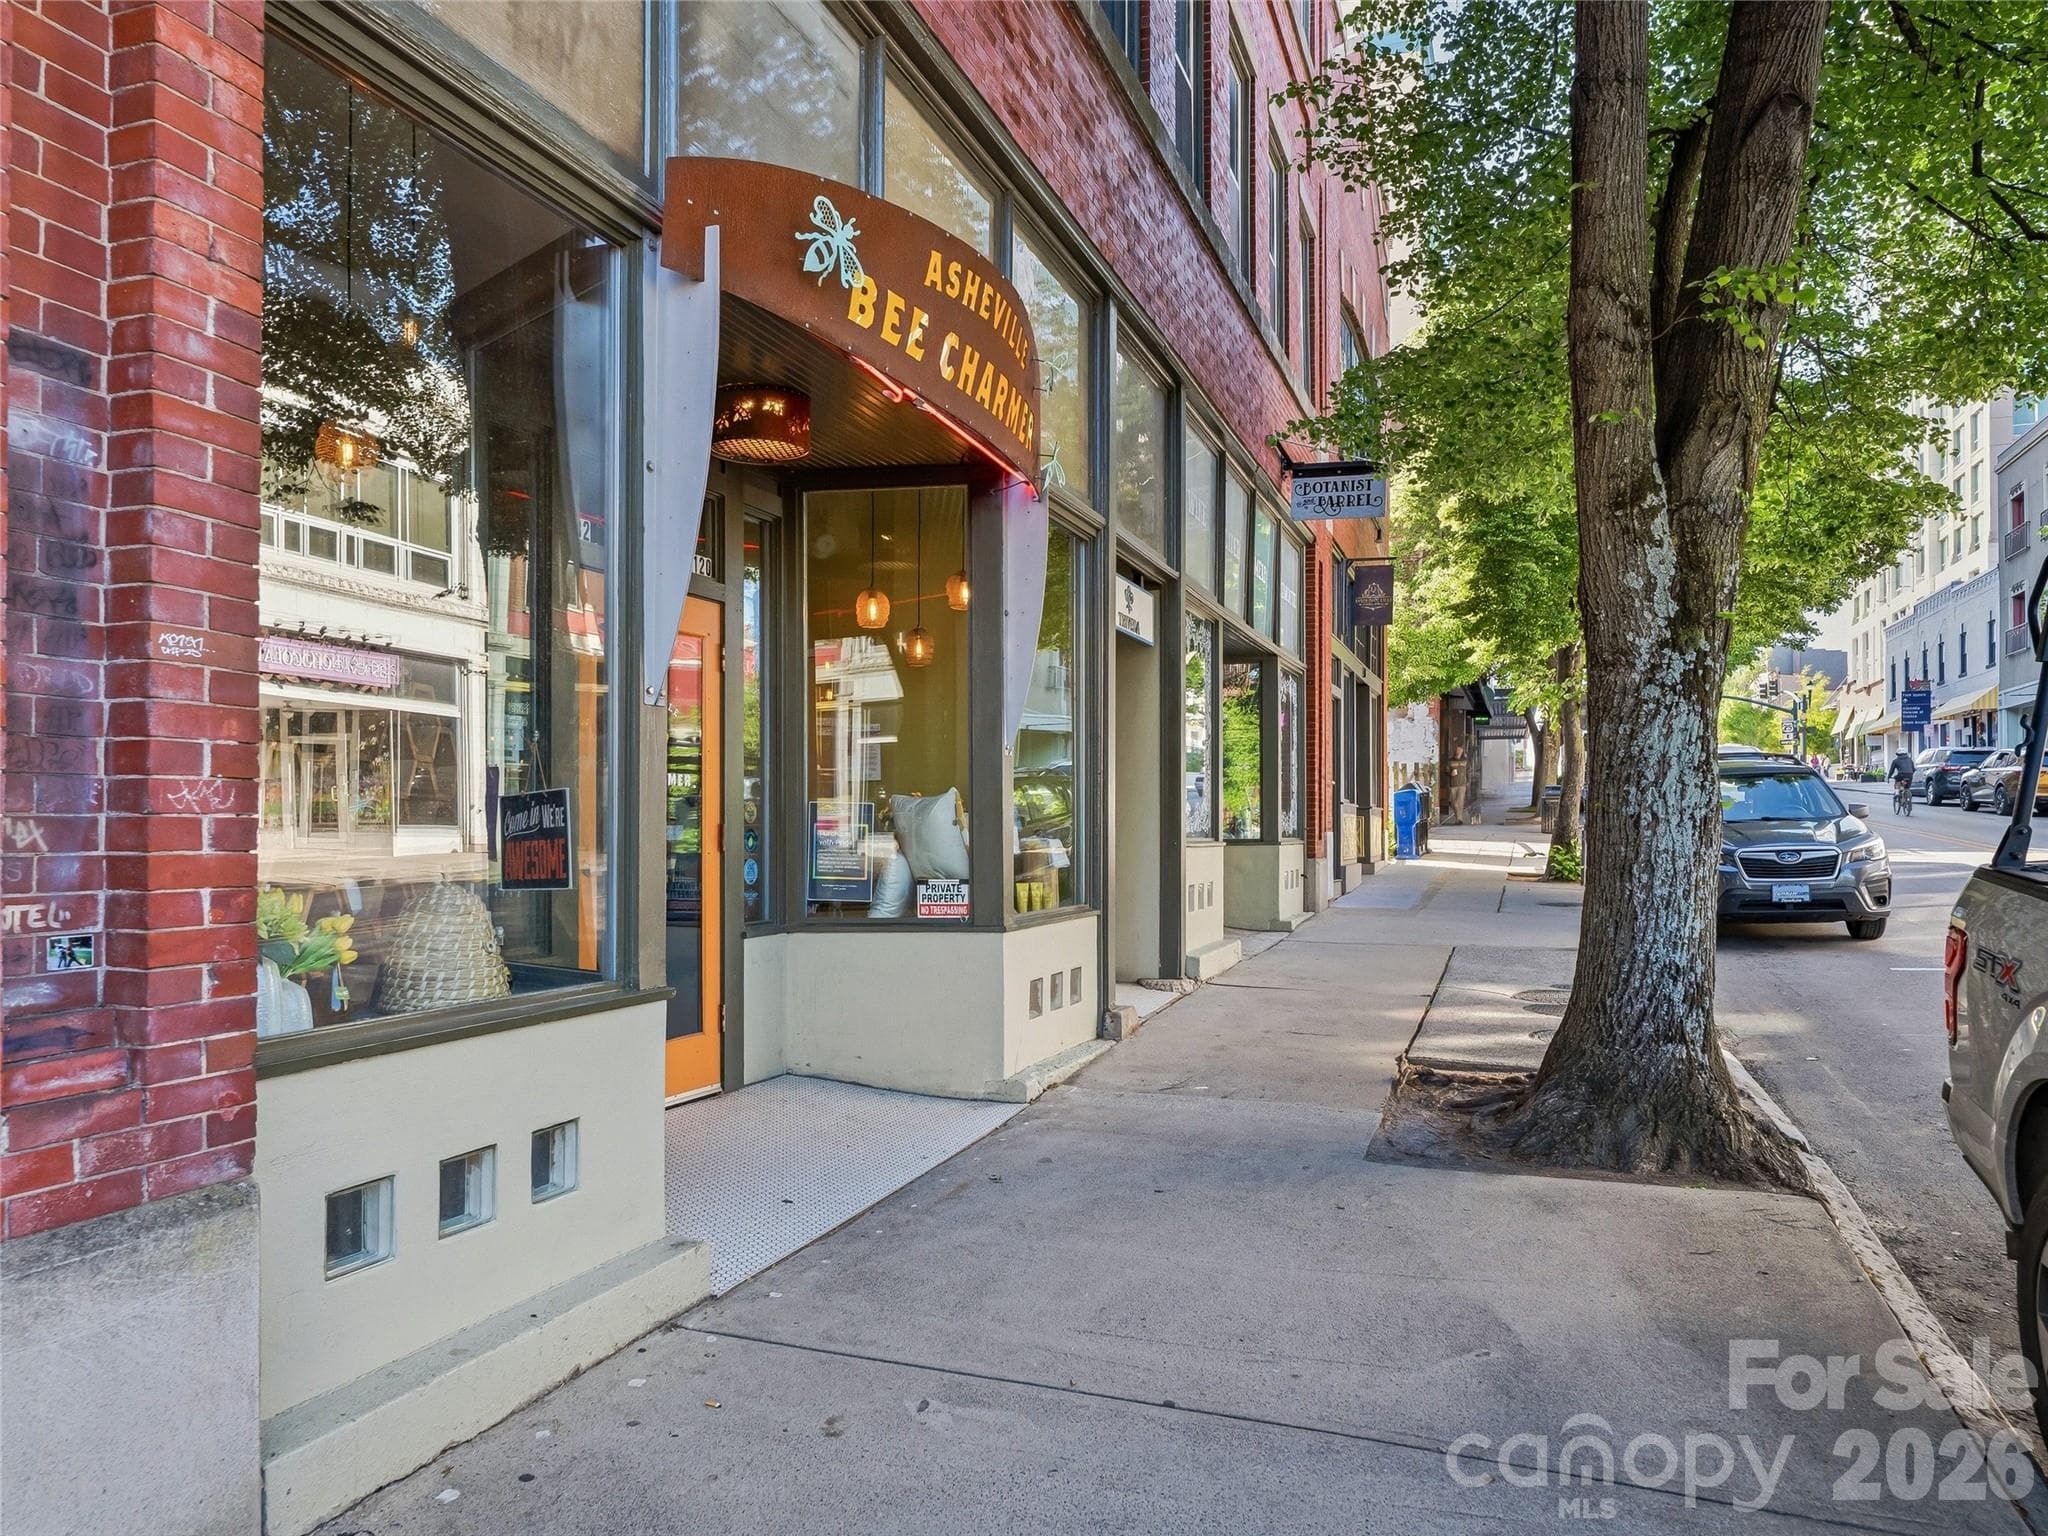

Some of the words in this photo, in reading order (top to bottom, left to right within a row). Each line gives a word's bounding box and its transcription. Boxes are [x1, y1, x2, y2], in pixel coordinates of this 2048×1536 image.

[924, 250, 1028, 369] ASHEVILLE
[848, 274, 929, 362] BEE
[939, 331, 1034, 452] CHARMER
[1294, 478, 1374, 497] BOTANIST
[1313, 493, 1384, 516] BARREL
[694, 556, 711, 576] 120
[504, 808, 530, 836] Come
[529, 800, 540, 826] in
[541, 803, 566, 828] WE'RE
[505, 838, 567, 880] AWESOME
[921, 893, 966, 903] PROPERTY
[925, 883, 963, 893] PRIVATE
[920, 905, 930, 915] NO
